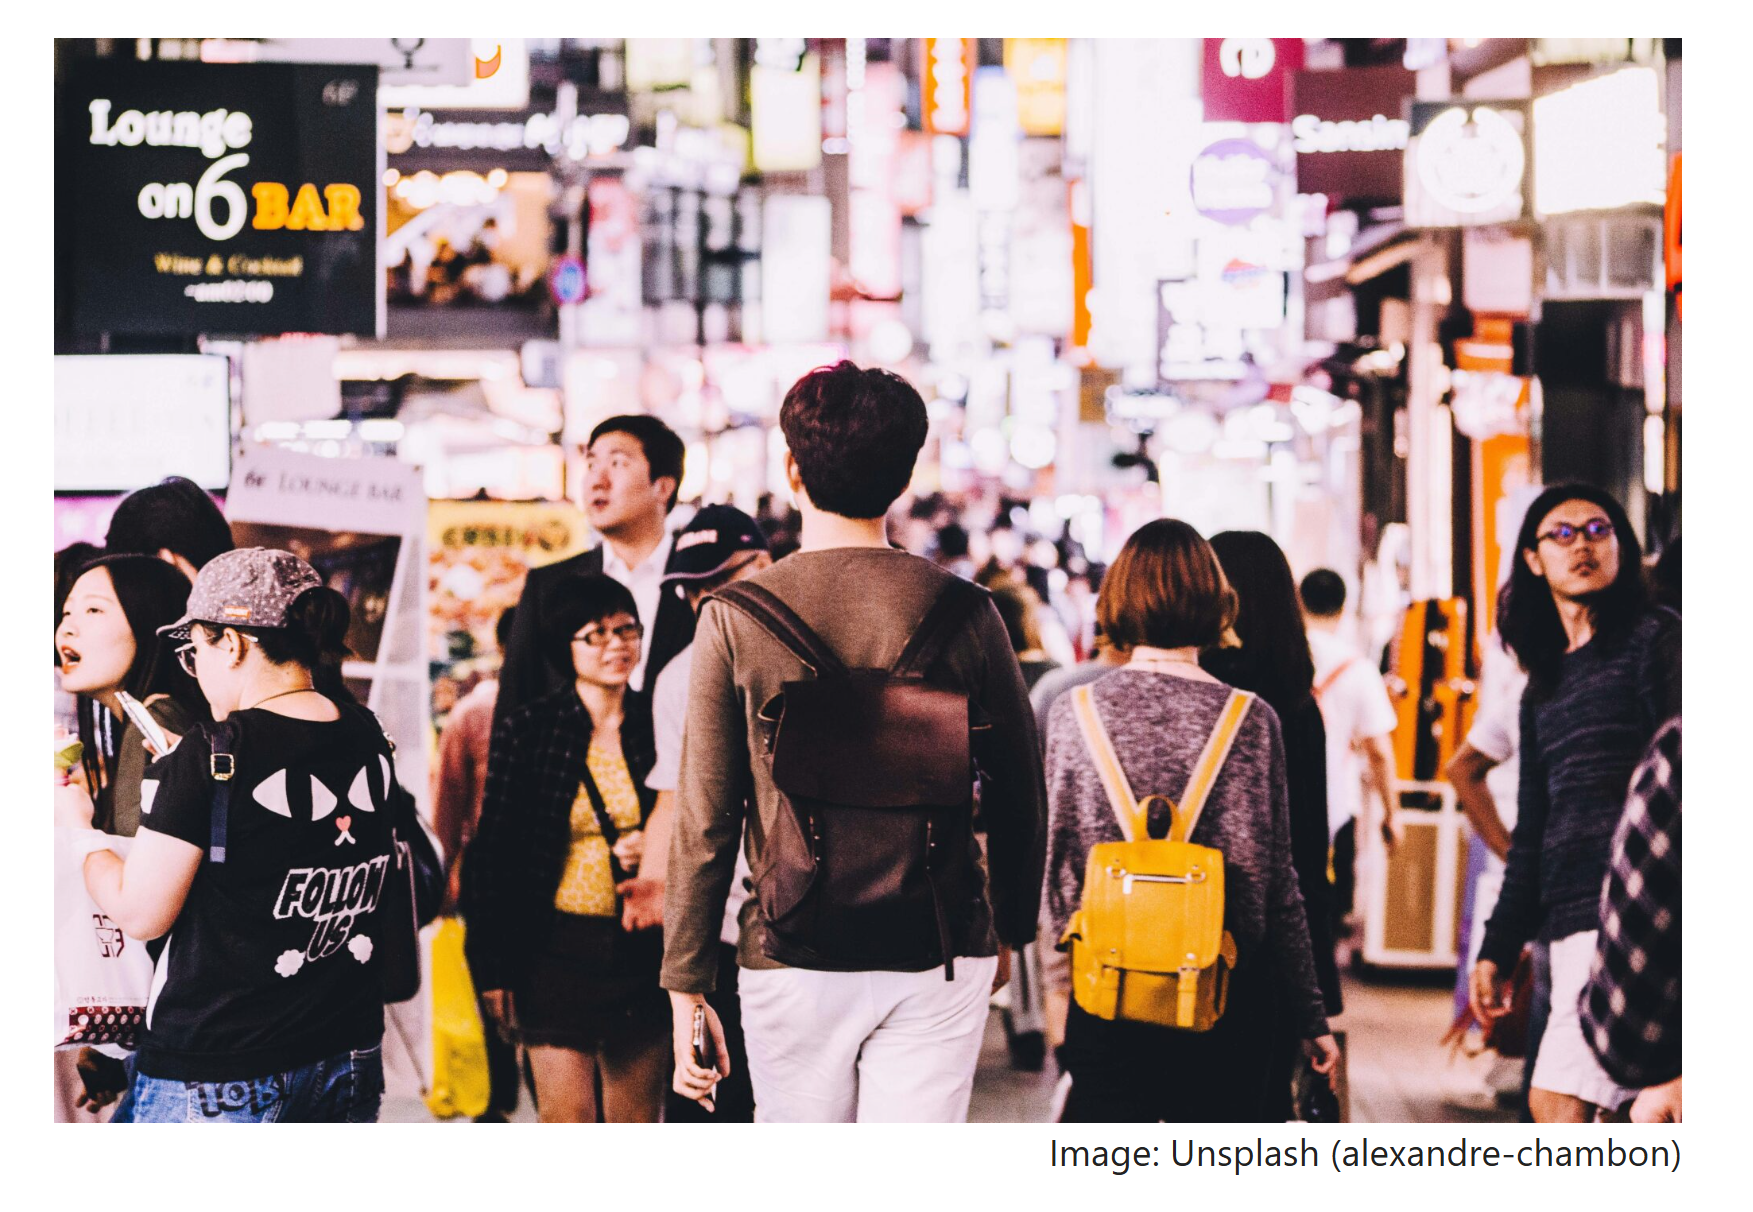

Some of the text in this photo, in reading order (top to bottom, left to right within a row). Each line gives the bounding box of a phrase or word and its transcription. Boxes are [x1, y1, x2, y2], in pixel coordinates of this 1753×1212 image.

[89, 99, 252, 159] Lounge
[138, 153, 365, 241] on 6 BAR
[154, 252, 202, 276] Wine
[273, 855, 390, 921] FOLLOW
[307, 914, 354, 962] US
